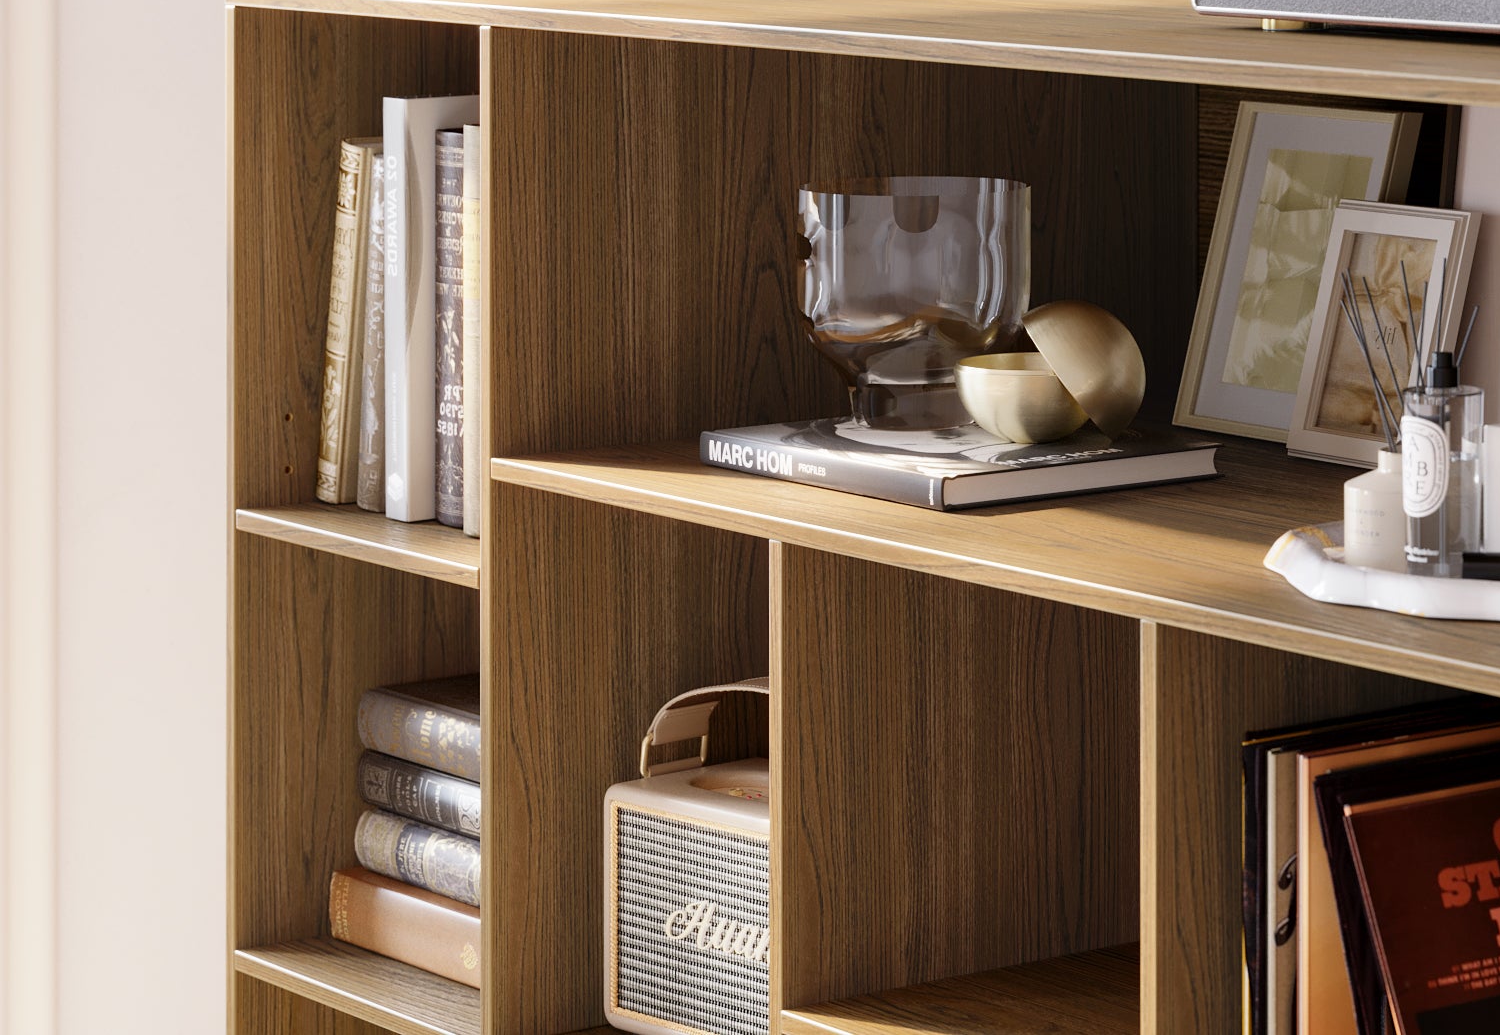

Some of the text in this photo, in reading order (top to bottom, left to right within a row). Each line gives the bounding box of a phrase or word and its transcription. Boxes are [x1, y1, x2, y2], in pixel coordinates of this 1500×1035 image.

[708, 439, 826, 477] MARC HOM PROFILES
